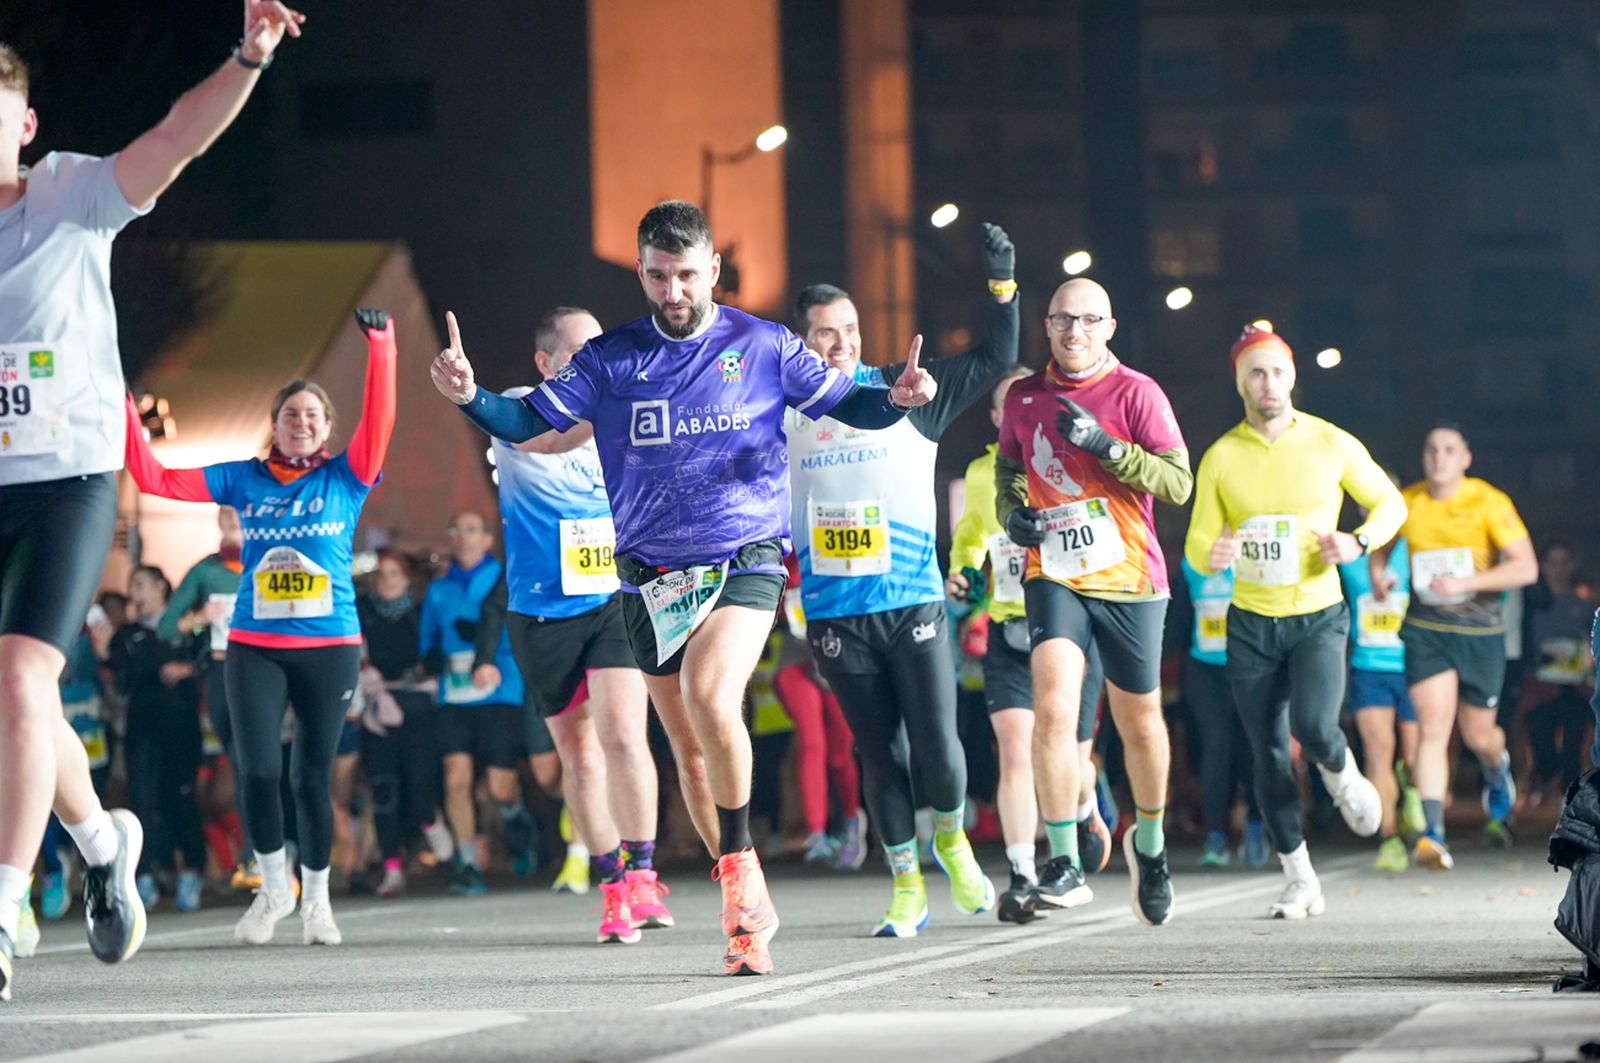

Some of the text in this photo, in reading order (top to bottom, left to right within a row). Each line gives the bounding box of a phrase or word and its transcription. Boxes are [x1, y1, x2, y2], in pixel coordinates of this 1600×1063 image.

[0, 370, 18, 383] ÓN
[675, 412, 751, 436] ABADES
[800, 447, 889, 470] MARACENA
[1045, 464, 1064, 485] 43
[825, 529, 872, 551] 3194
[1058, 525, 1095, 552] 720
[1241, 541, 1281, 561] 4319
[268, 572, 315, 593] 4457
